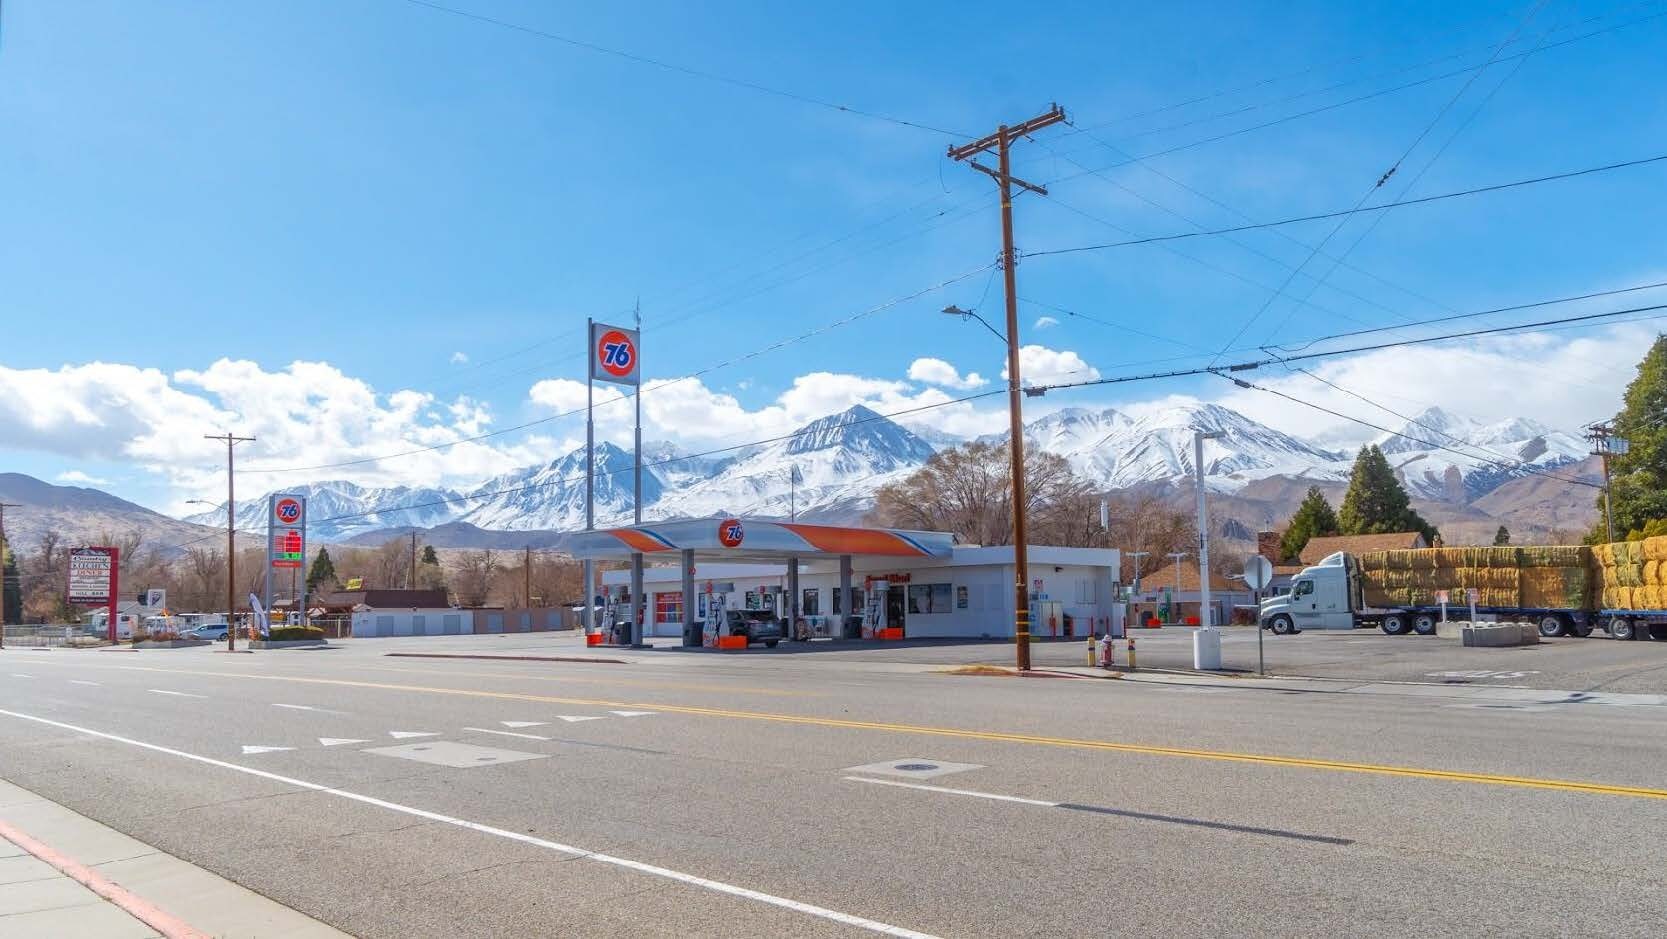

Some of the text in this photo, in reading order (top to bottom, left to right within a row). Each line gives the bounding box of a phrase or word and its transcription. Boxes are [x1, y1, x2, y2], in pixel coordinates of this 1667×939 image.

[603, 341, 631, 368] 76
[281, 503, 297, 518] 76
[727, 525, 743, 541] 76
